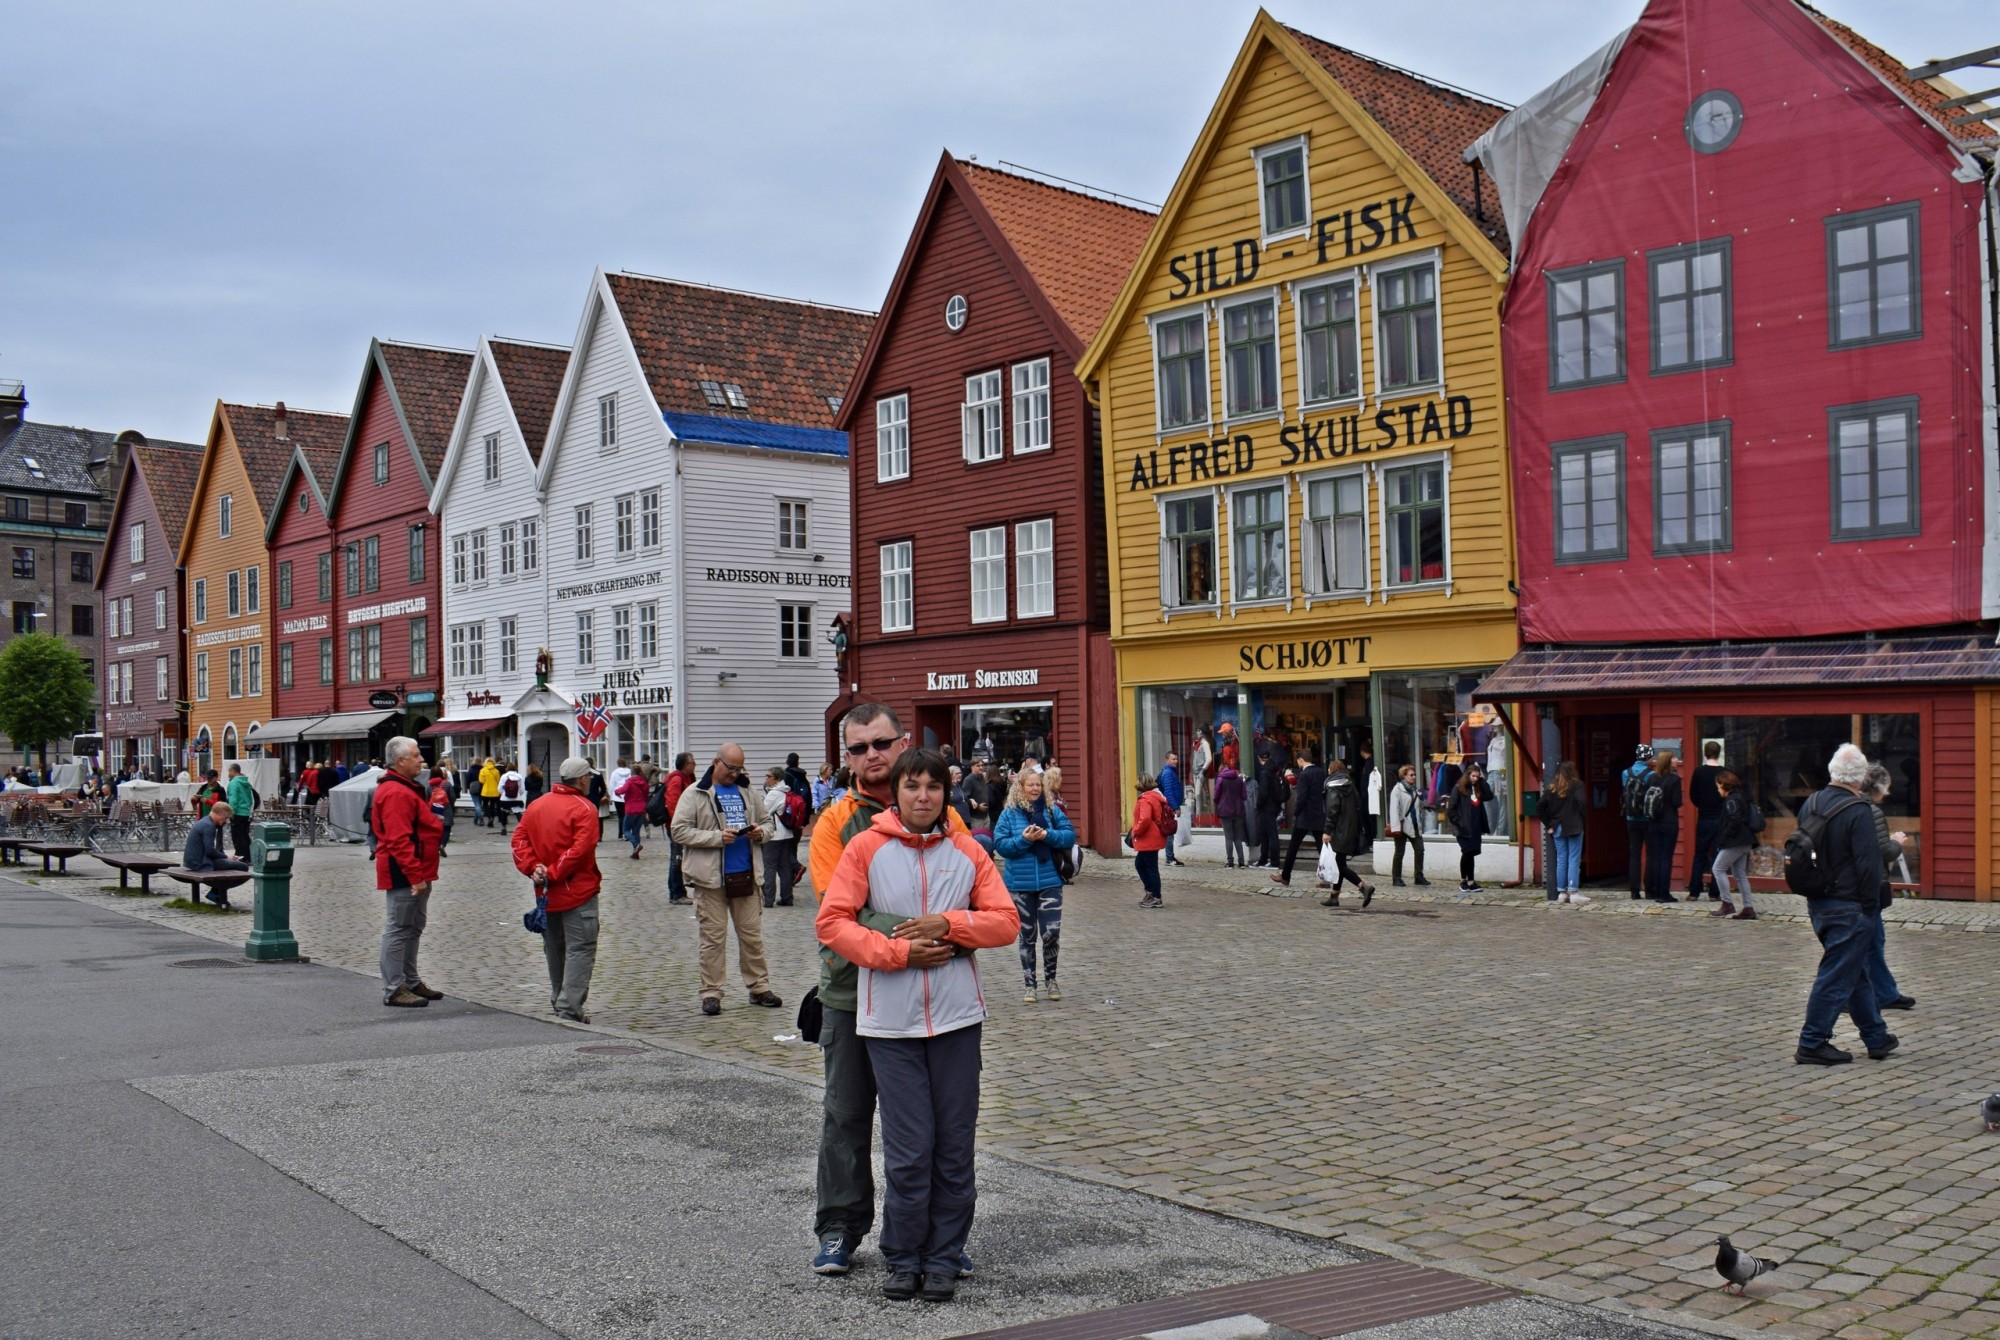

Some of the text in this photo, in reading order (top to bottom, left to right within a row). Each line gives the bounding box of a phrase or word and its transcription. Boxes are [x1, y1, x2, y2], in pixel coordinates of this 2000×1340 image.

[1169, 238, 1260, 300] SILD
[1316, 193, 1418, 265] FISK
[1130, 395, 1472, 492] ALFRED SKULSTAD
[557, 572, 663, 600] NETWORK CHARTERING INT.
[706, 568, 780, 584] RADISSON
[786, 572, 812, 586] BLU
[382, 597, 427, 617] NIGHTCLUB
[196, 624, 262, 647] RADISSON BLU HOTEL
[283, 618, 309, 634] MADAM
[1240, 636, 1372, 672] SCHJØTT
[603, 668, 644, 689] JUHLS'
[927, 669, 1038, 691] KJETIL SØRENSEN
[623, 686, 672, 706] GALLERY
